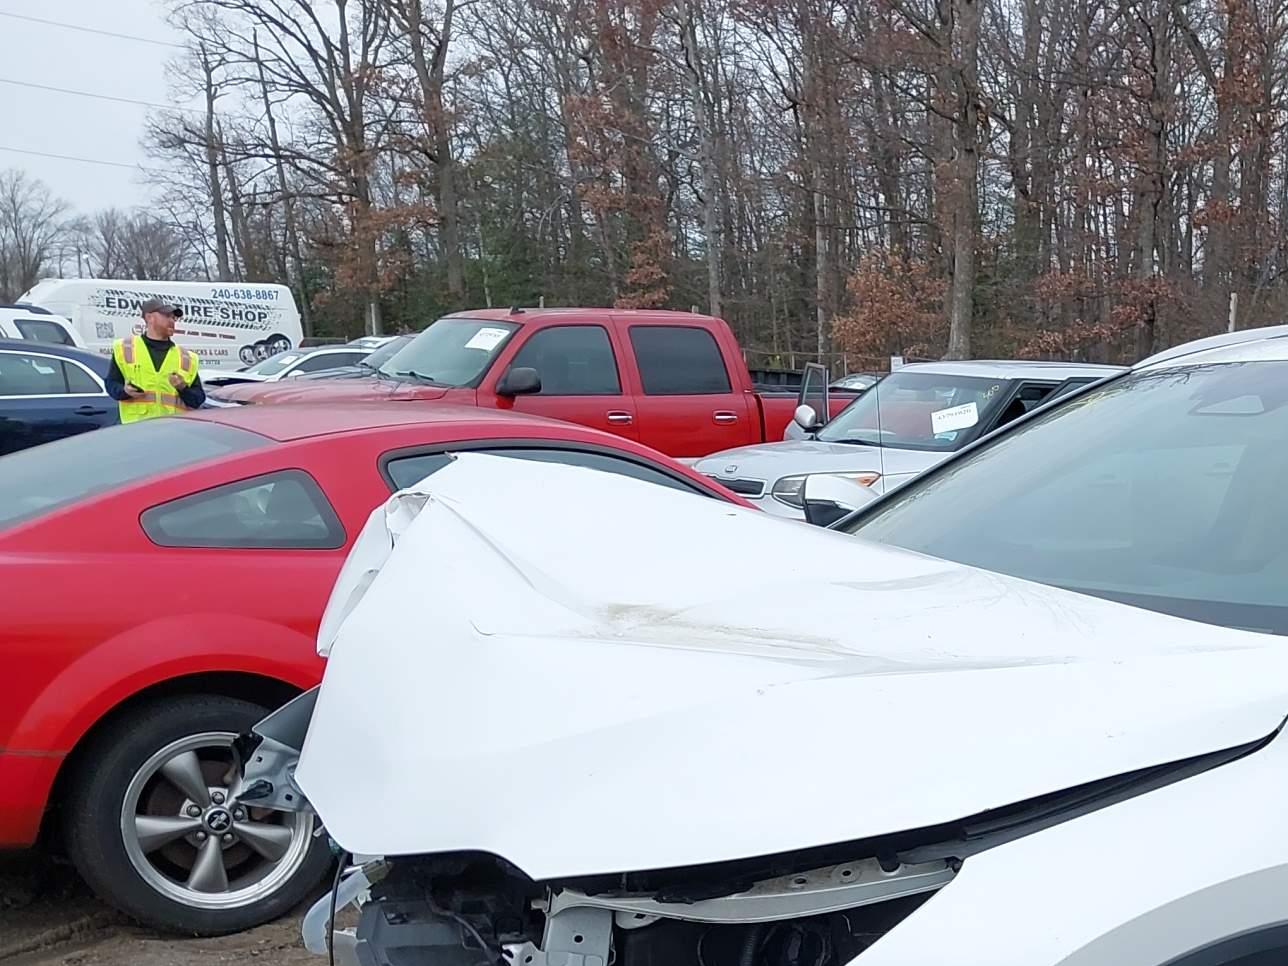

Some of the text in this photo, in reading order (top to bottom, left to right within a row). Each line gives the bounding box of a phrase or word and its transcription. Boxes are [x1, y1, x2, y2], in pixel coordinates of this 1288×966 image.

[211, 288, 279, 300] 240-638-8867
[105, 297, 142, 311] EDW
[219, 306, 268, 323] SHOP
